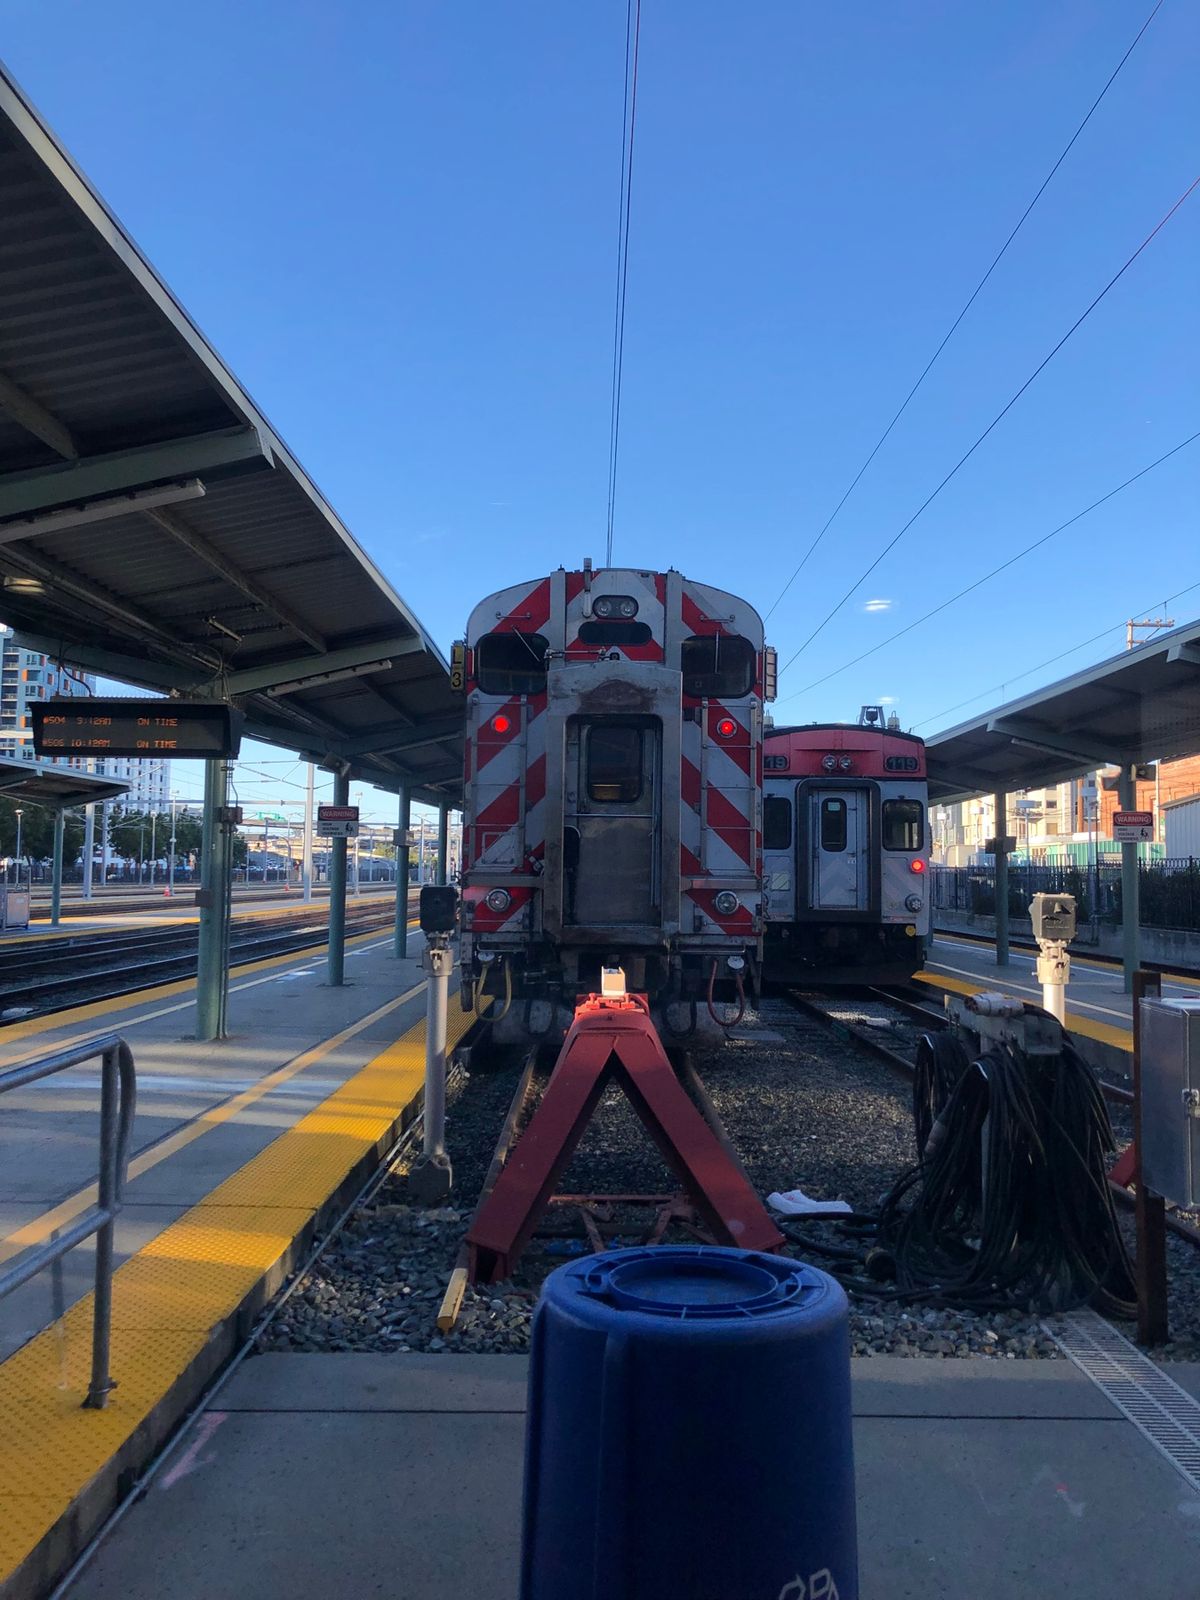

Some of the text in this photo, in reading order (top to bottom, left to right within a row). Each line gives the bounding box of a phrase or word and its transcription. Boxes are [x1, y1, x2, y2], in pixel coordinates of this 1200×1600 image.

[452, 671, 461, 687] 3
[137, 717, 150, 726] ON
[155, 718, 178, 726] TIME
[136, 740, 149, 749] ON
[154, 740, 177, 749] TIME
[889, 757, 917, 770] 119
[322, 809, 355, 818] WARNING
[1117, 815, 1150, 823] WARNING
